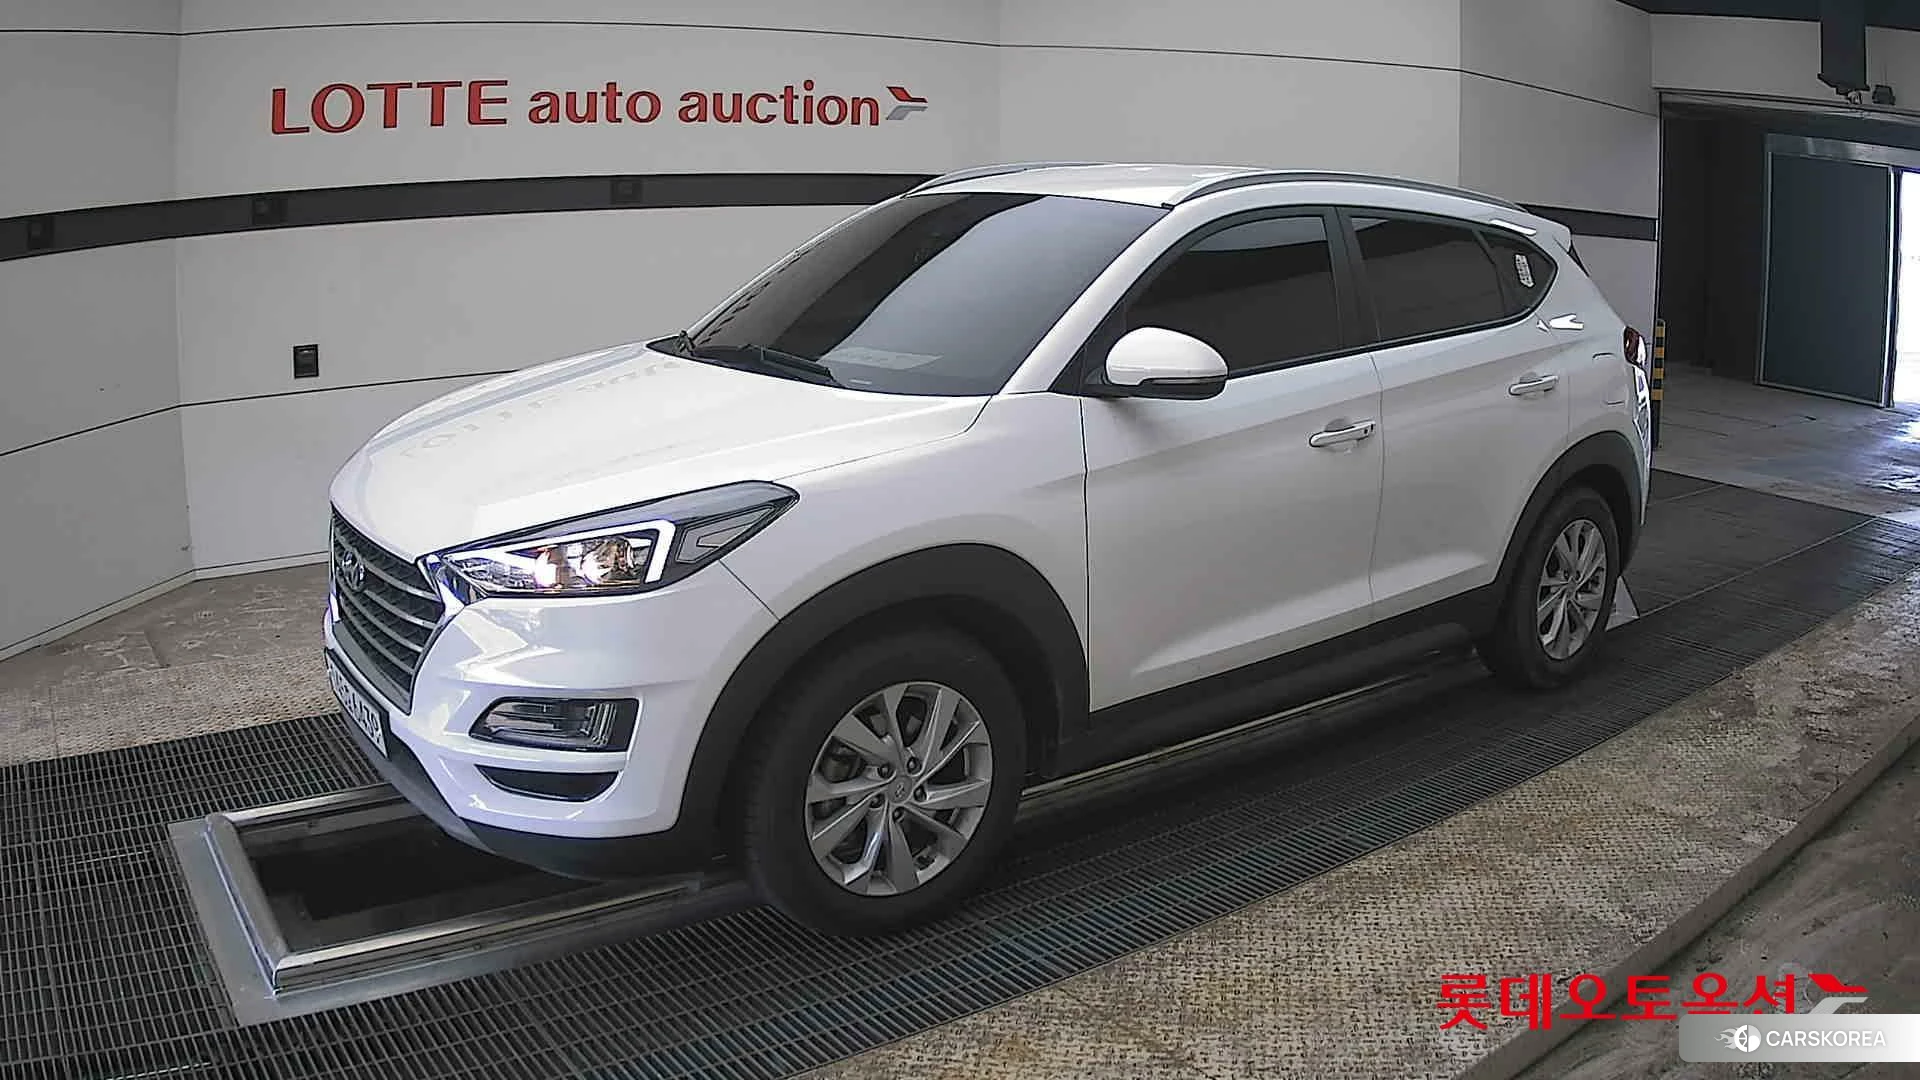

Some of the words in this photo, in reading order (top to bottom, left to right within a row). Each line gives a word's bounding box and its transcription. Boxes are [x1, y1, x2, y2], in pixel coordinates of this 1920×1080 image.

[270, 79, 509, 135] LOTTE
[528, 81, 662, 124] auto
[678, 79, 880, 126] auction
